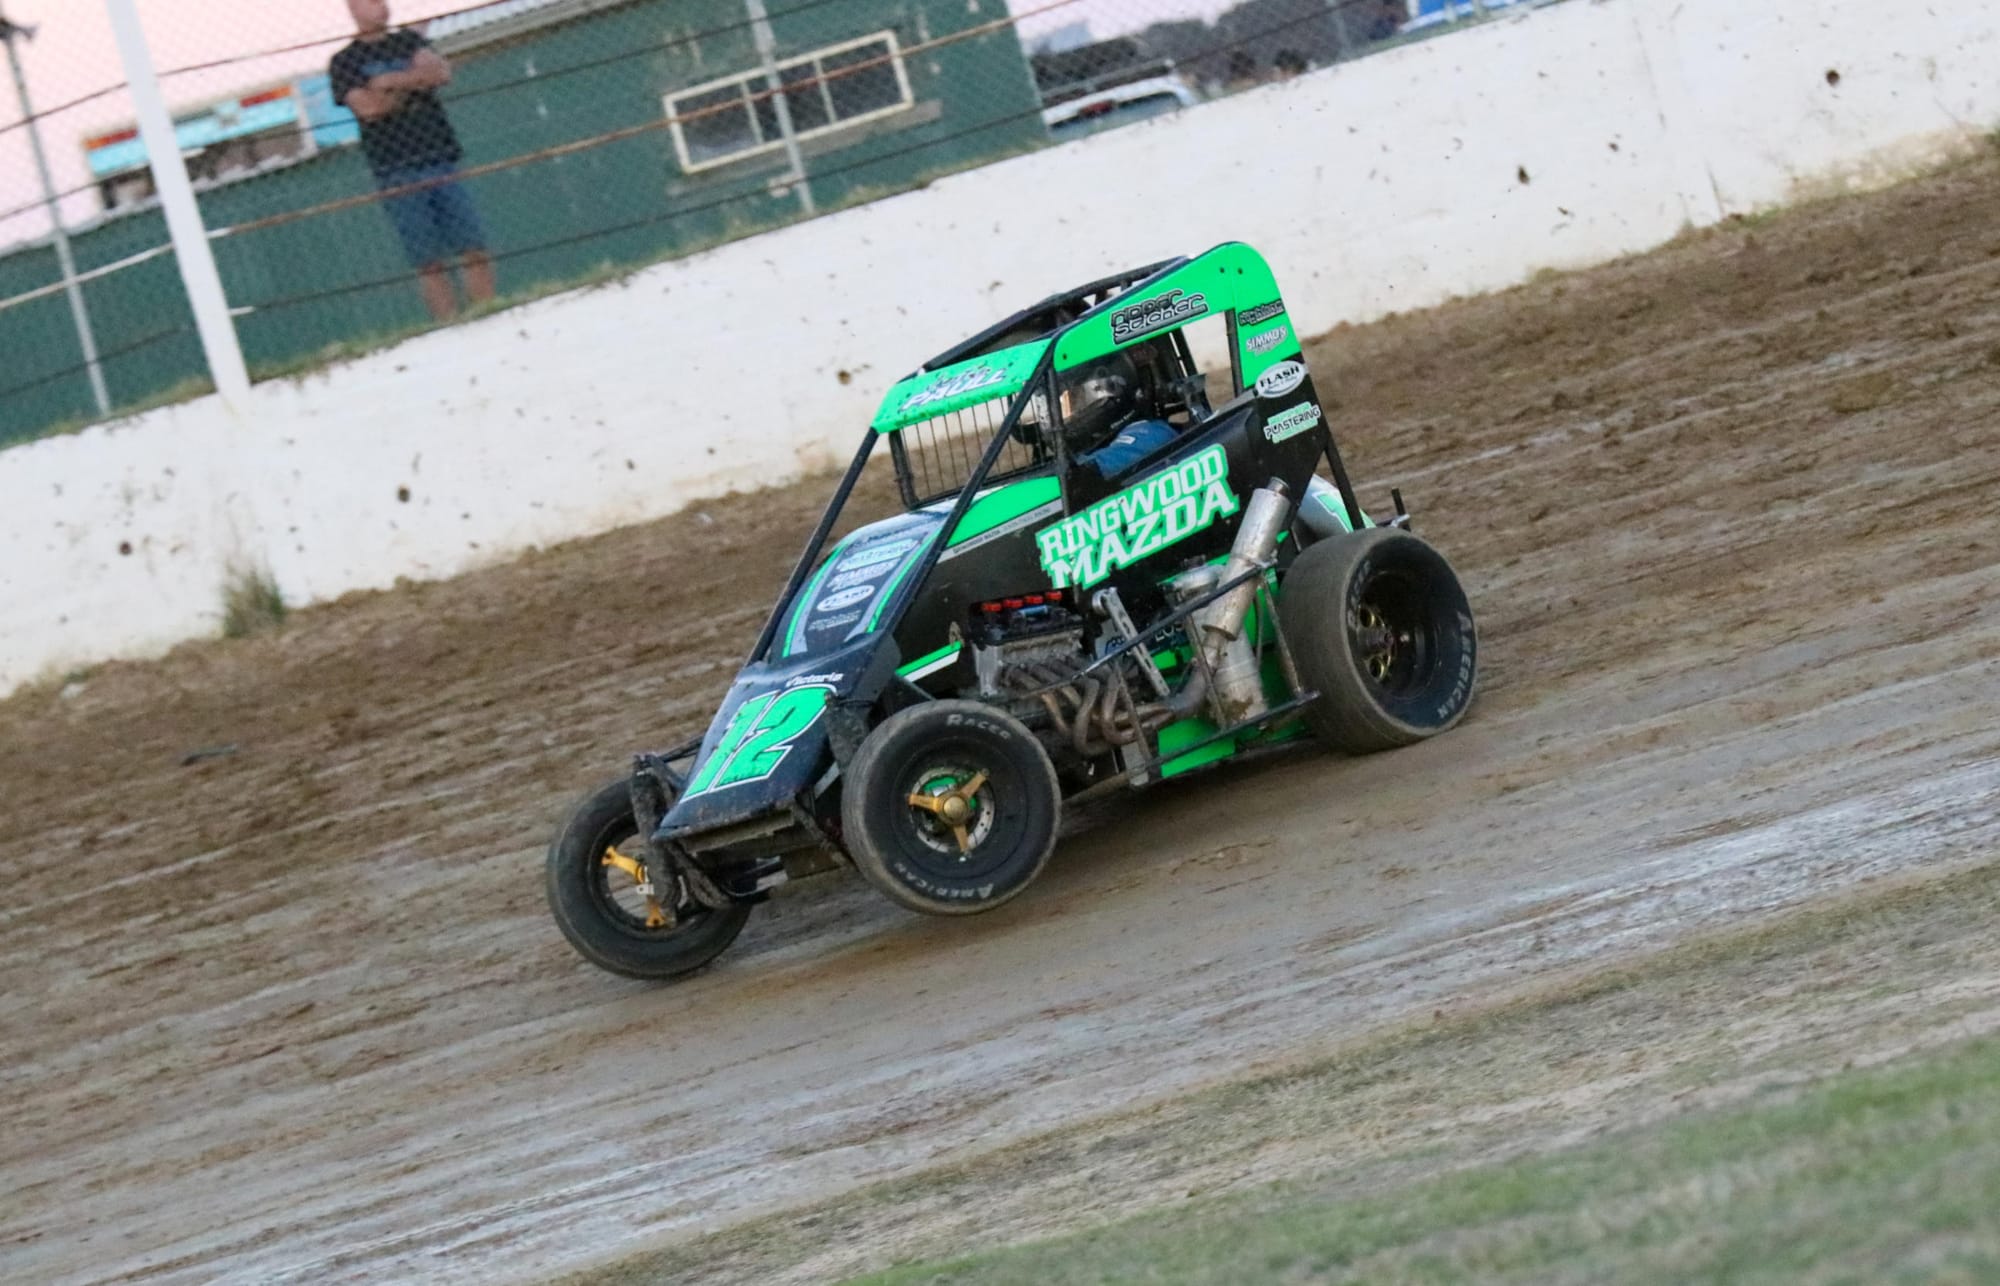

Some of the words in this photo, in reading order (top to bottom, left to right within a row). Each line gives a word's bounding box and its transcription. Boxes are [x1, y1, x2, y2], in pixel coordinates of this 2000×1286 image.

[1260, 365, 1300, 388] FLASH
[1265, 406, 1320, 438] PLASTERING
[1039, 449, 1225, 566] RINGWOOD
[1050, 480, 1235, 589] MAZDA
[1437, 610, 1473, 720] AMERICAN
[679, 683, 838, 803] 12
[946, 713, 1012, 740] RACER
